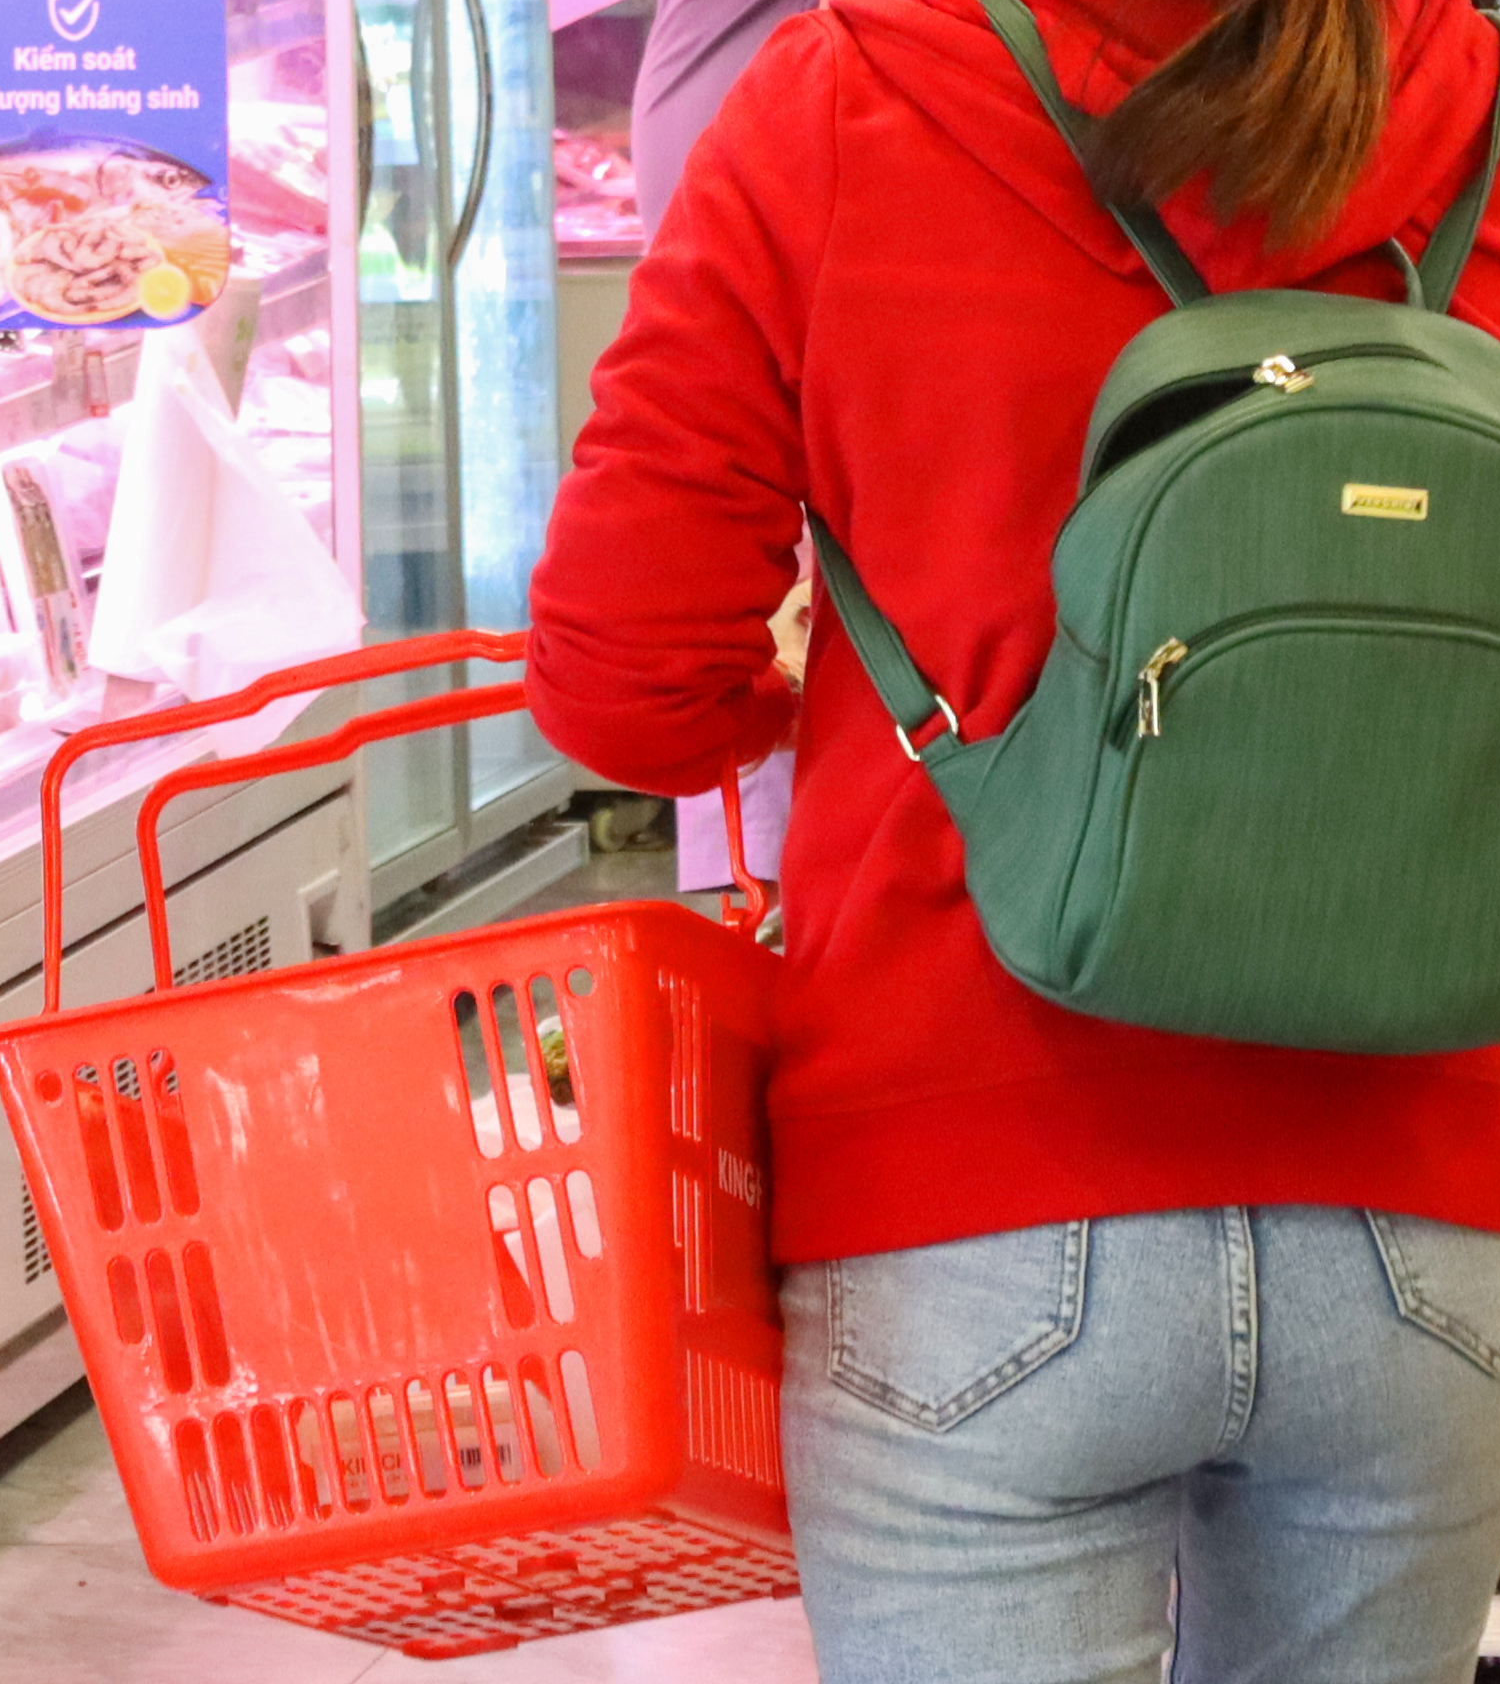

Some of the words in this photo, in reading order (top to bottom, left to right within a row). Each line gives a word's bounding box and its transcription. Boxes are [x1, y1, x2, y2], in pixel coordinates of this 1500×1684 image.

[13, 43, 78, 71] Kiểm
[82, 45, 137, 71] soát
[66, 83, 142, 115] kháng
[147, 83, 200, 109] sinh
